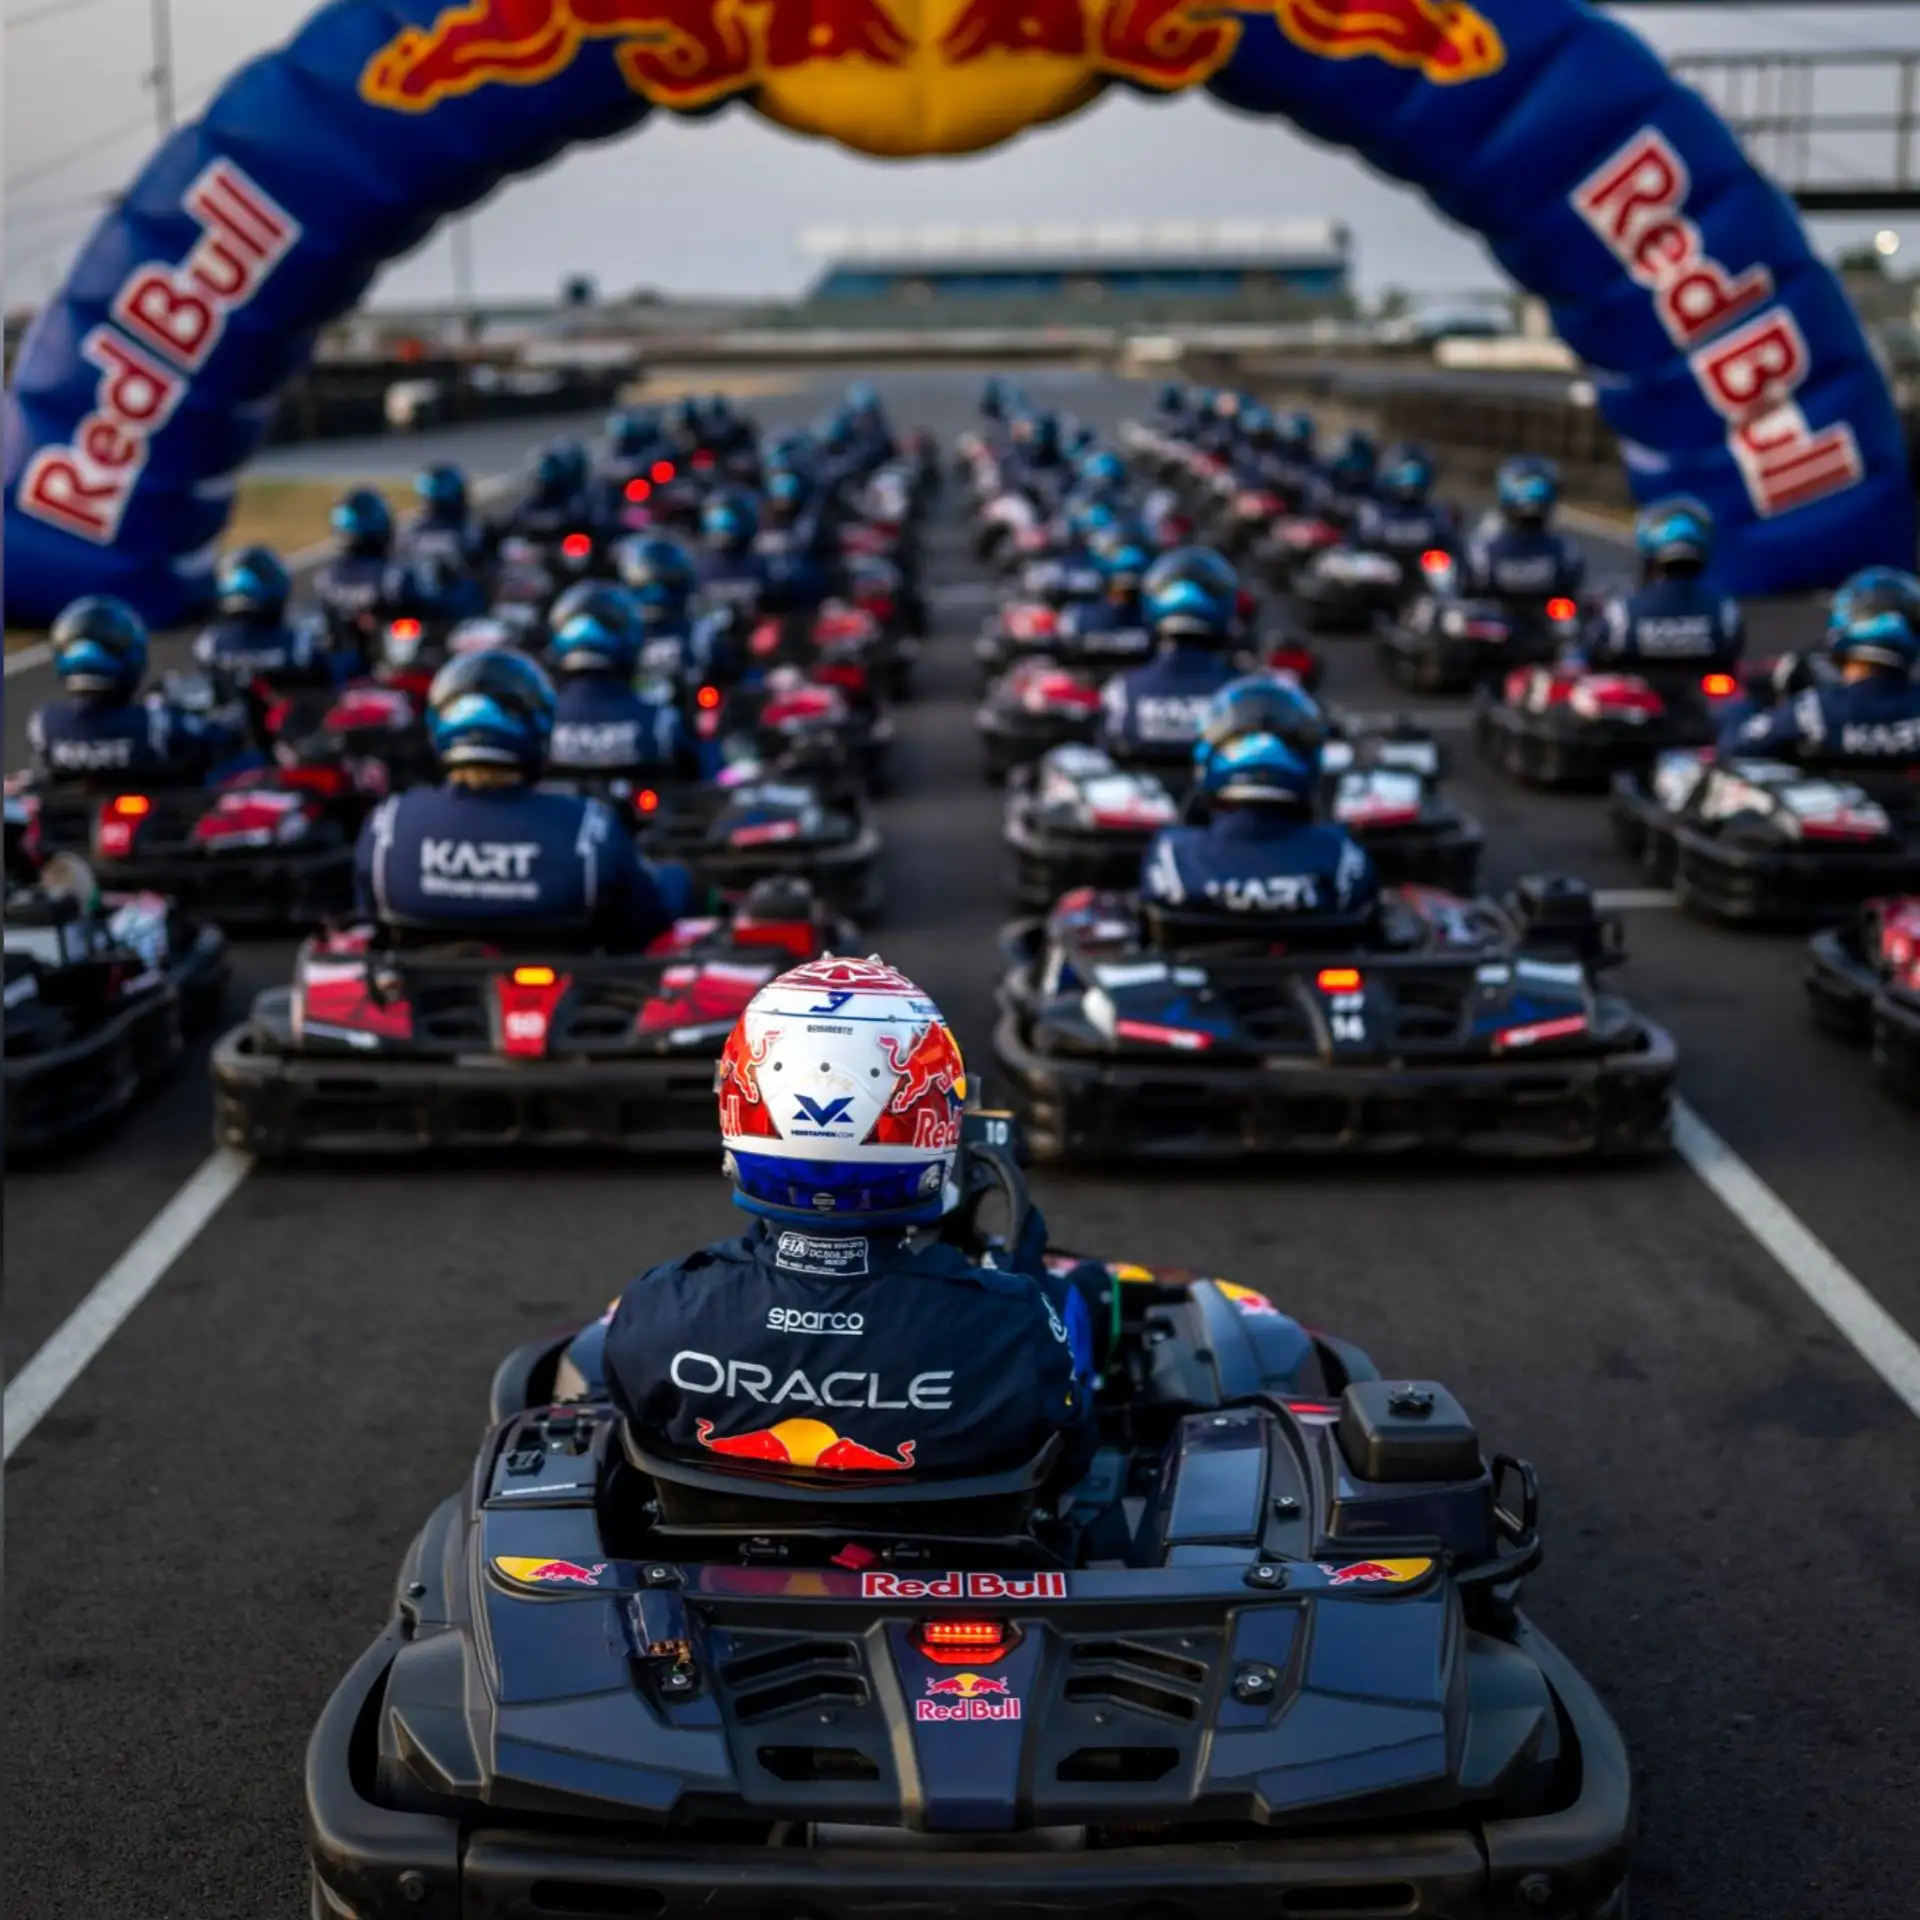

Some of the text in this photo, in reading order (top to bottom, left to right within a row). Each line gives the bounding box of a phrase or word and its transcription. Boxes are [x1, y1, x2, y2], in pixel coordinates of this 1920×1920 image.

[1571, 128, 1863, 518] Red Bull
[17, 158, 302, 544] Red Bull
[421, 838, 541, 877] KART
[984, 1120, 1008, 1145] 10
[766, 1306, 864, 1335] sparco
[670, 1350, 955, 1410] ORACLE
[862, 1572, 1067, 1598] Red Bull
[916, 1698, 1021, 1721] Red Bull
